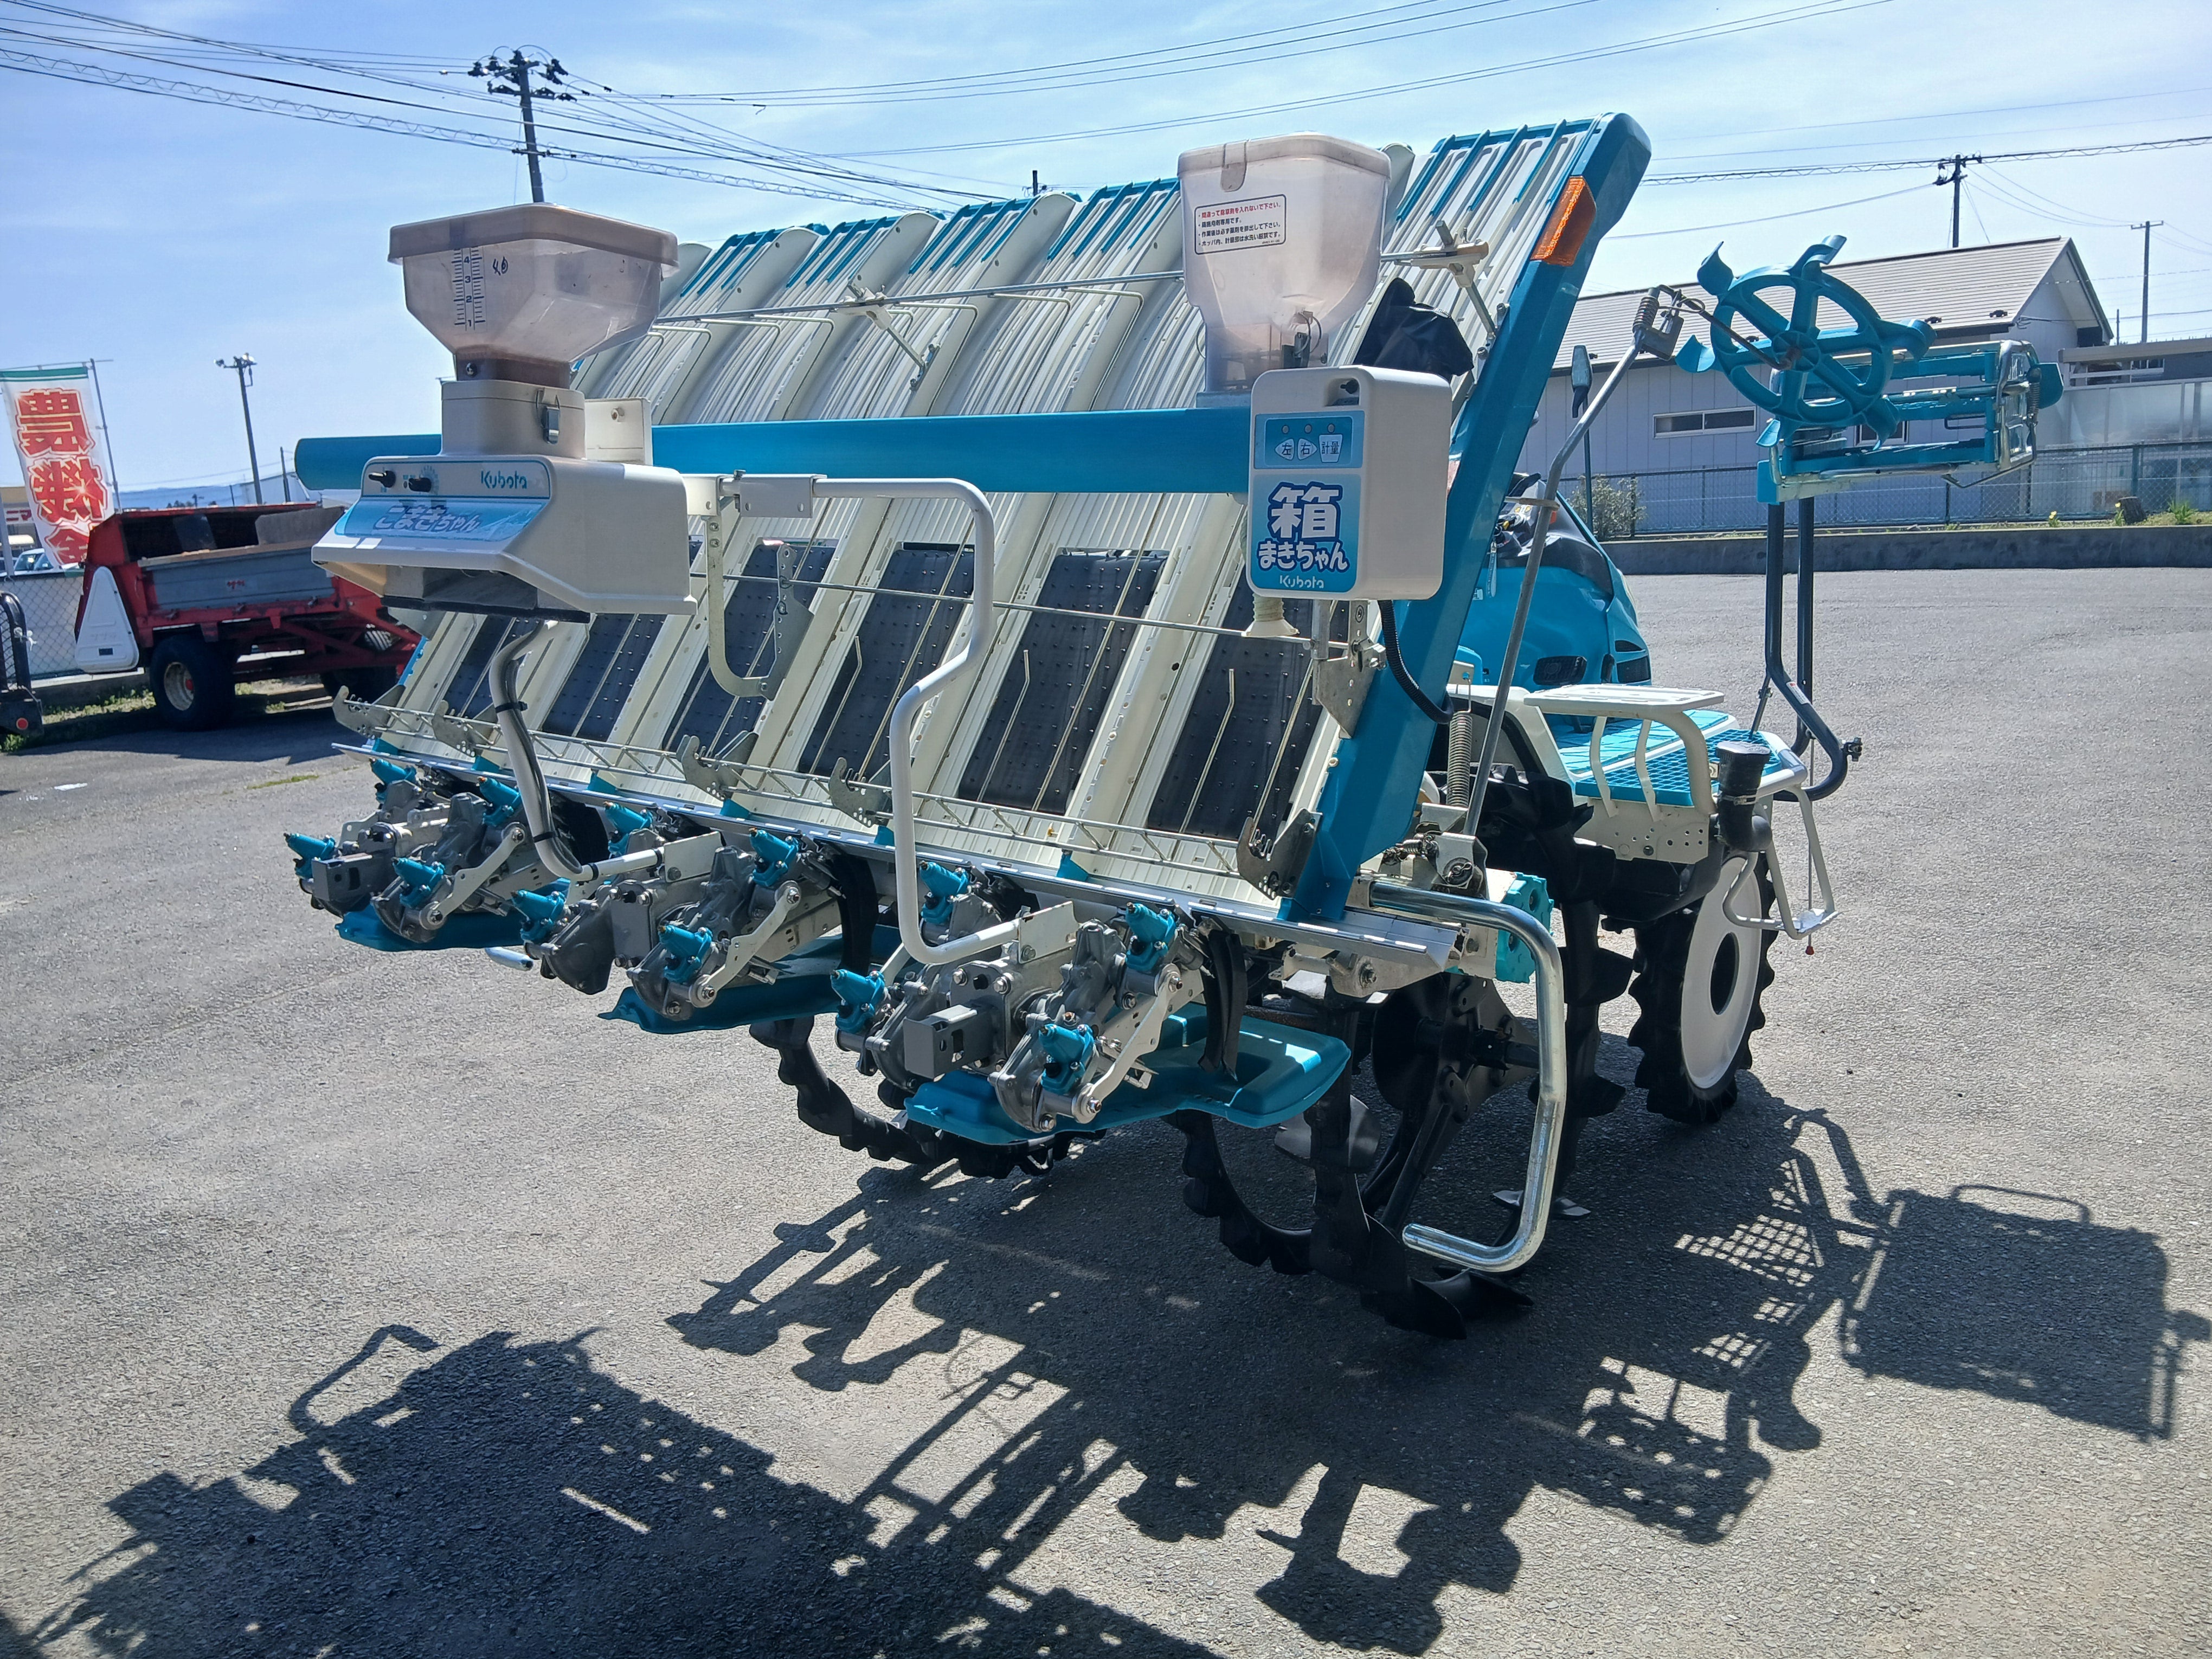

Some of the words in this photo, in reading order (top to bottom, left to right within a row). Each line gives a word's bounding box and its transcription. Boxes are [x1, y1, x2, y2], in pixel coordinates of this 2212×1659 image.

[1281, 443, 1291, 456] 左
[1301, 443, 1311, 455] 右
[1321, 441, 1340, 455] 計量
[481, 470, 527, 489] Kubota
[1269, 484, 1341, 540] 箱
[1258, 540, 1349, 572] まきちゃん
[1279, 575, 1324, 589] Kubota
